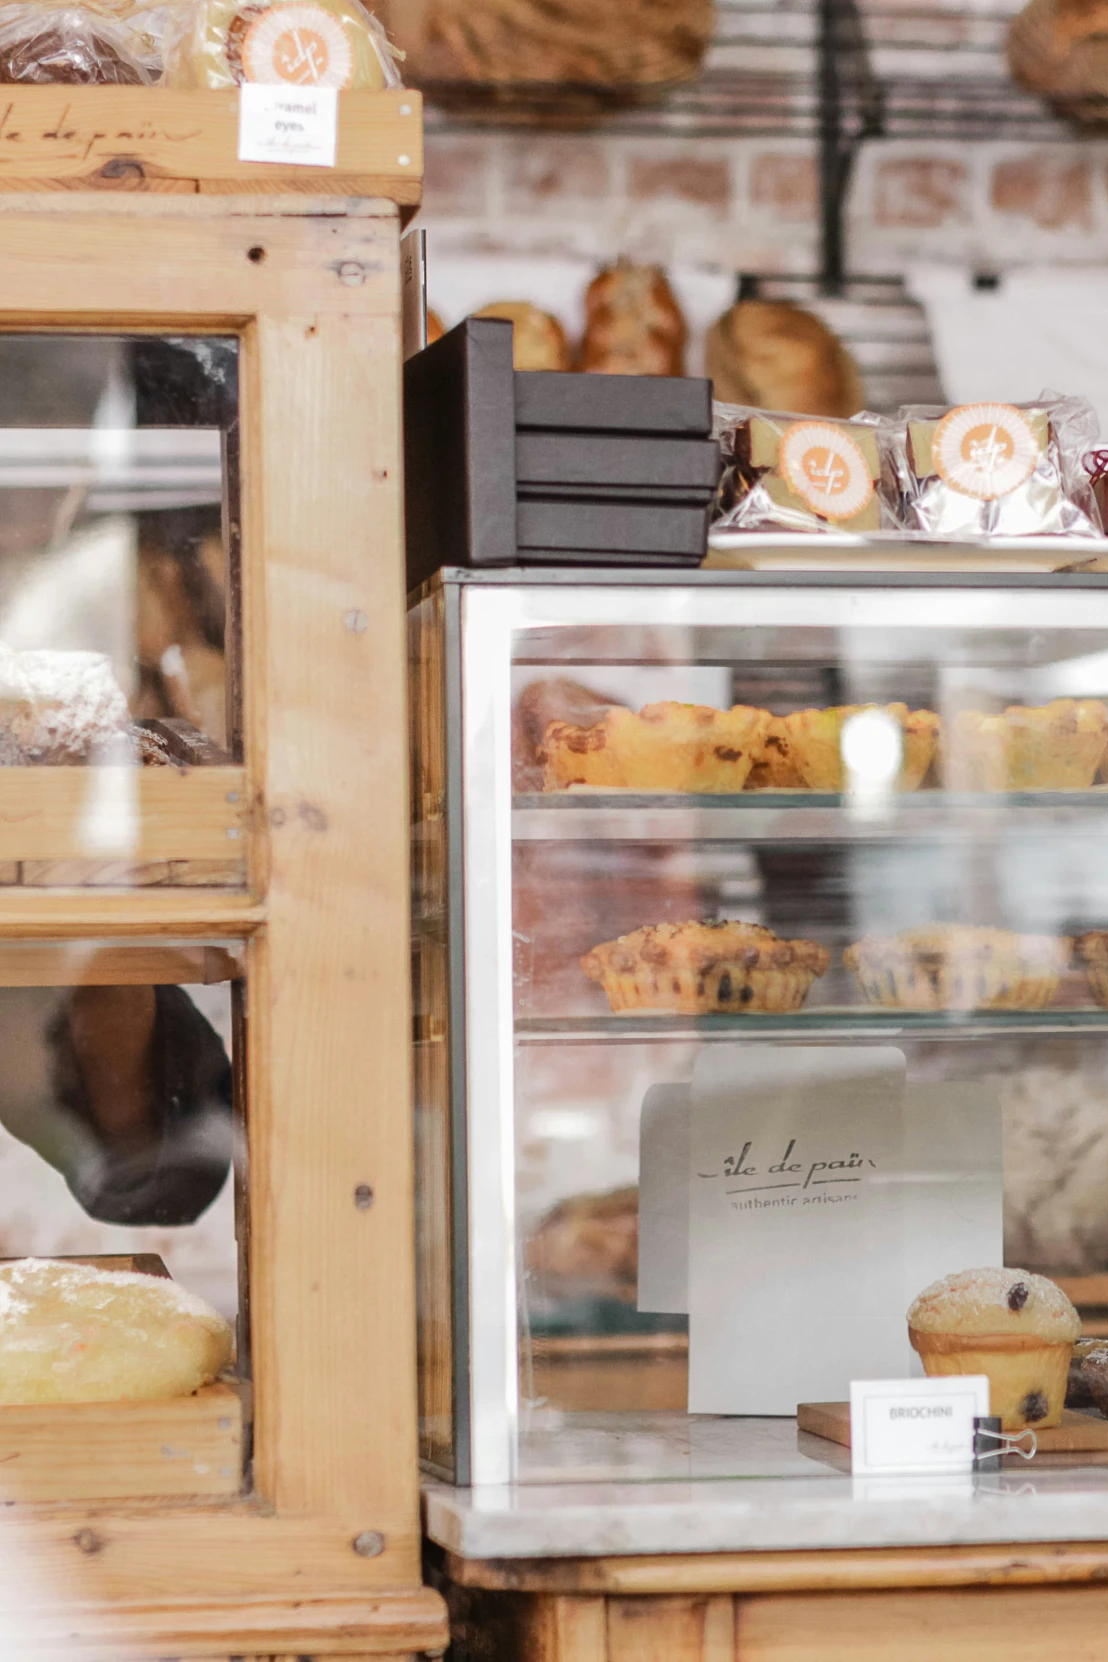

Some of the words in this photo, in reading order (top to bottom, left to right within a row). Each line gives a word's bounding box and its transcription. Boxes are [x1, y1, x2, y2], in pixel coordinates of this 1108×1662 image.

[274, 120, 304, 132] eyes
[768, 1139, 802, 1173] de
[890, 1406, 953, 1419] BRIOCHINI
